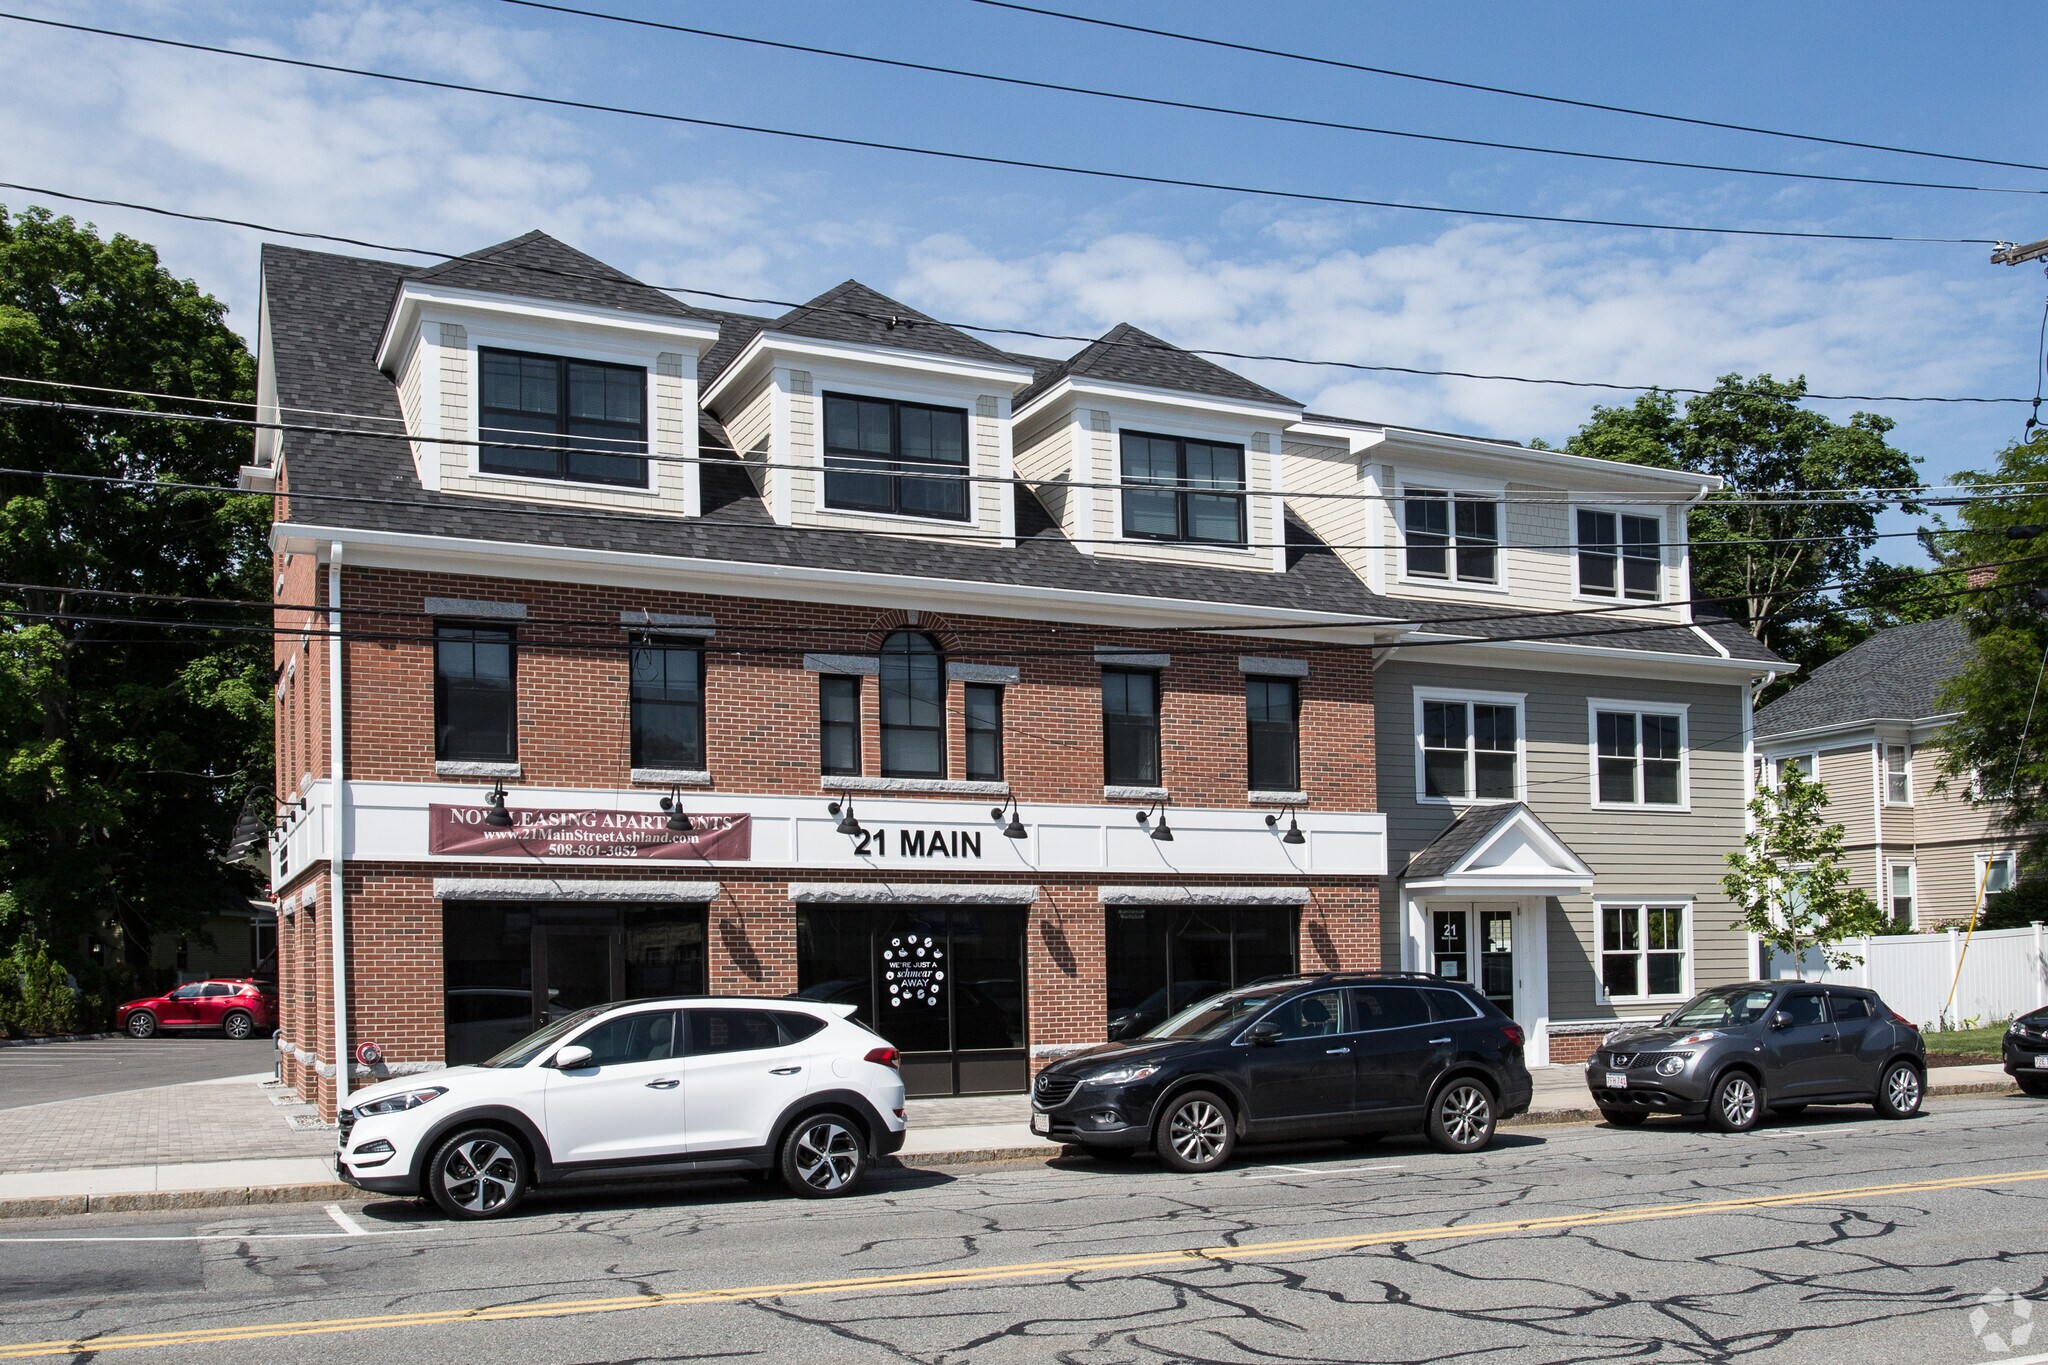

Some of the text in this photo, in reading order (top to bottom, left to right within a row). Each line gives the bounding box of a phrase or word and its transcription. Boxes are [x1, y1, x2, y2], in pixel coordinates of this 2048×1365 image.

[450, 808, 733, 831] NO LEASING APARTENTS
[484, 828, 700, 844] www.21MainStreetAshland.com
[854, 829, 982, 858] 21 MAIN
[549, 843, 638, 858] 508-861-3052
[1444, 924, 1456, 936] 21
[900, 979, 930, 987] AWAY
